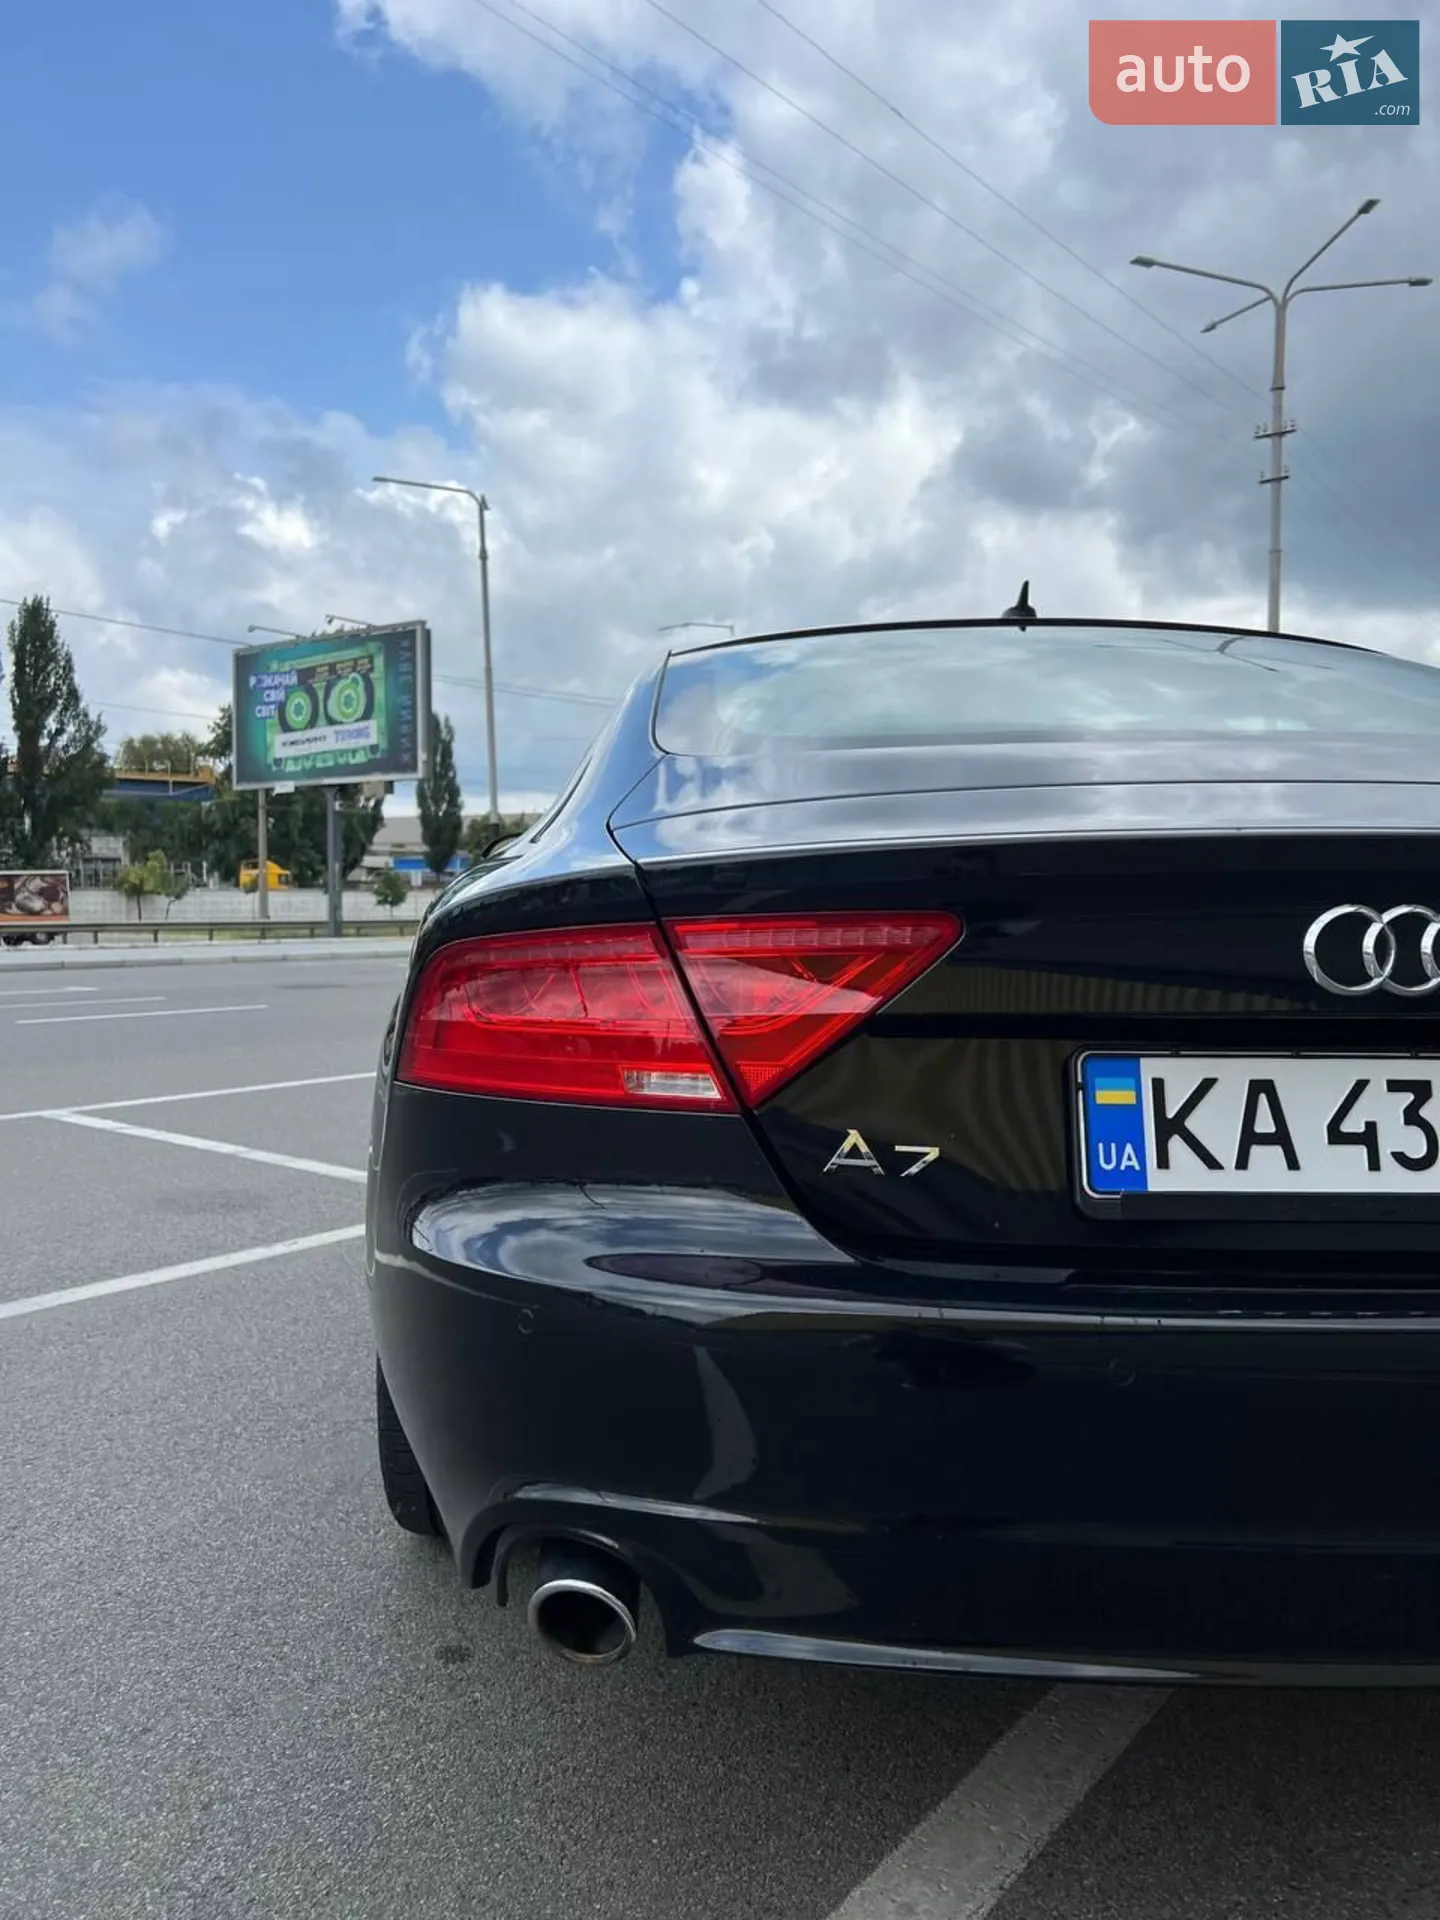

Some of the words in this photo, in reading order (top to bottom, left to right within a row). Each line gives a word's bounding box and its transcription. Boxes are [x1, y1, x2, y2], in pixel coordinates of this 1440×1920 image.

[1151, 1077, 1300, 1171] KA
[822, 1128, 940, 1177] A7
[1098, 1142, 1141, 1171] UA
